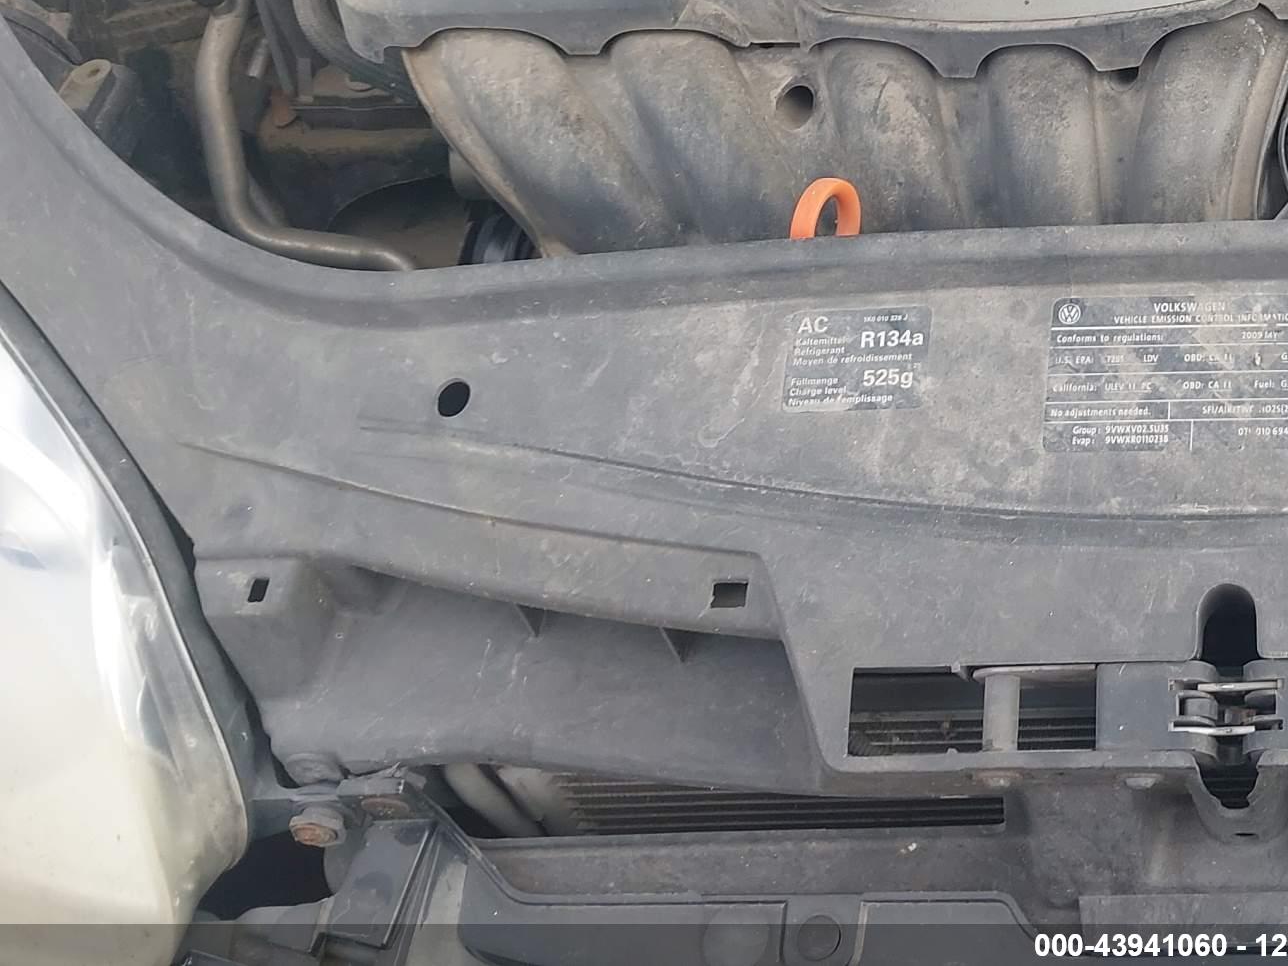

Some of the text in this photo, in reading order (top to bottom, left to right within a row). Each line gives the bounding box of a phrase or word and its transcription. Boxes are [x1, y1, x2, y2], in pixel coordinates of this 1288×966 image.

[797, 315, 829, 334] AC
[1114, 315, 1148, 325] VEHICLE
[1151, 314, 1192, 324] EMISSION
[860, 329, 925, 349] R134a
[1056, 332, 1164, 345] Conforms to regulations:
[794, 346, 846, 357] Refrigerant
[792, 353, 914, 368] Moyen de refroidissement
[1143, 354, 1159, 363] LDV
[863, 368, 914, 389] 525g
[1208, 380, 1220, 390] CA
[789, 385, 847, 398] Charge level
[1050, 405, 1152, 420] No adjustments needed.
